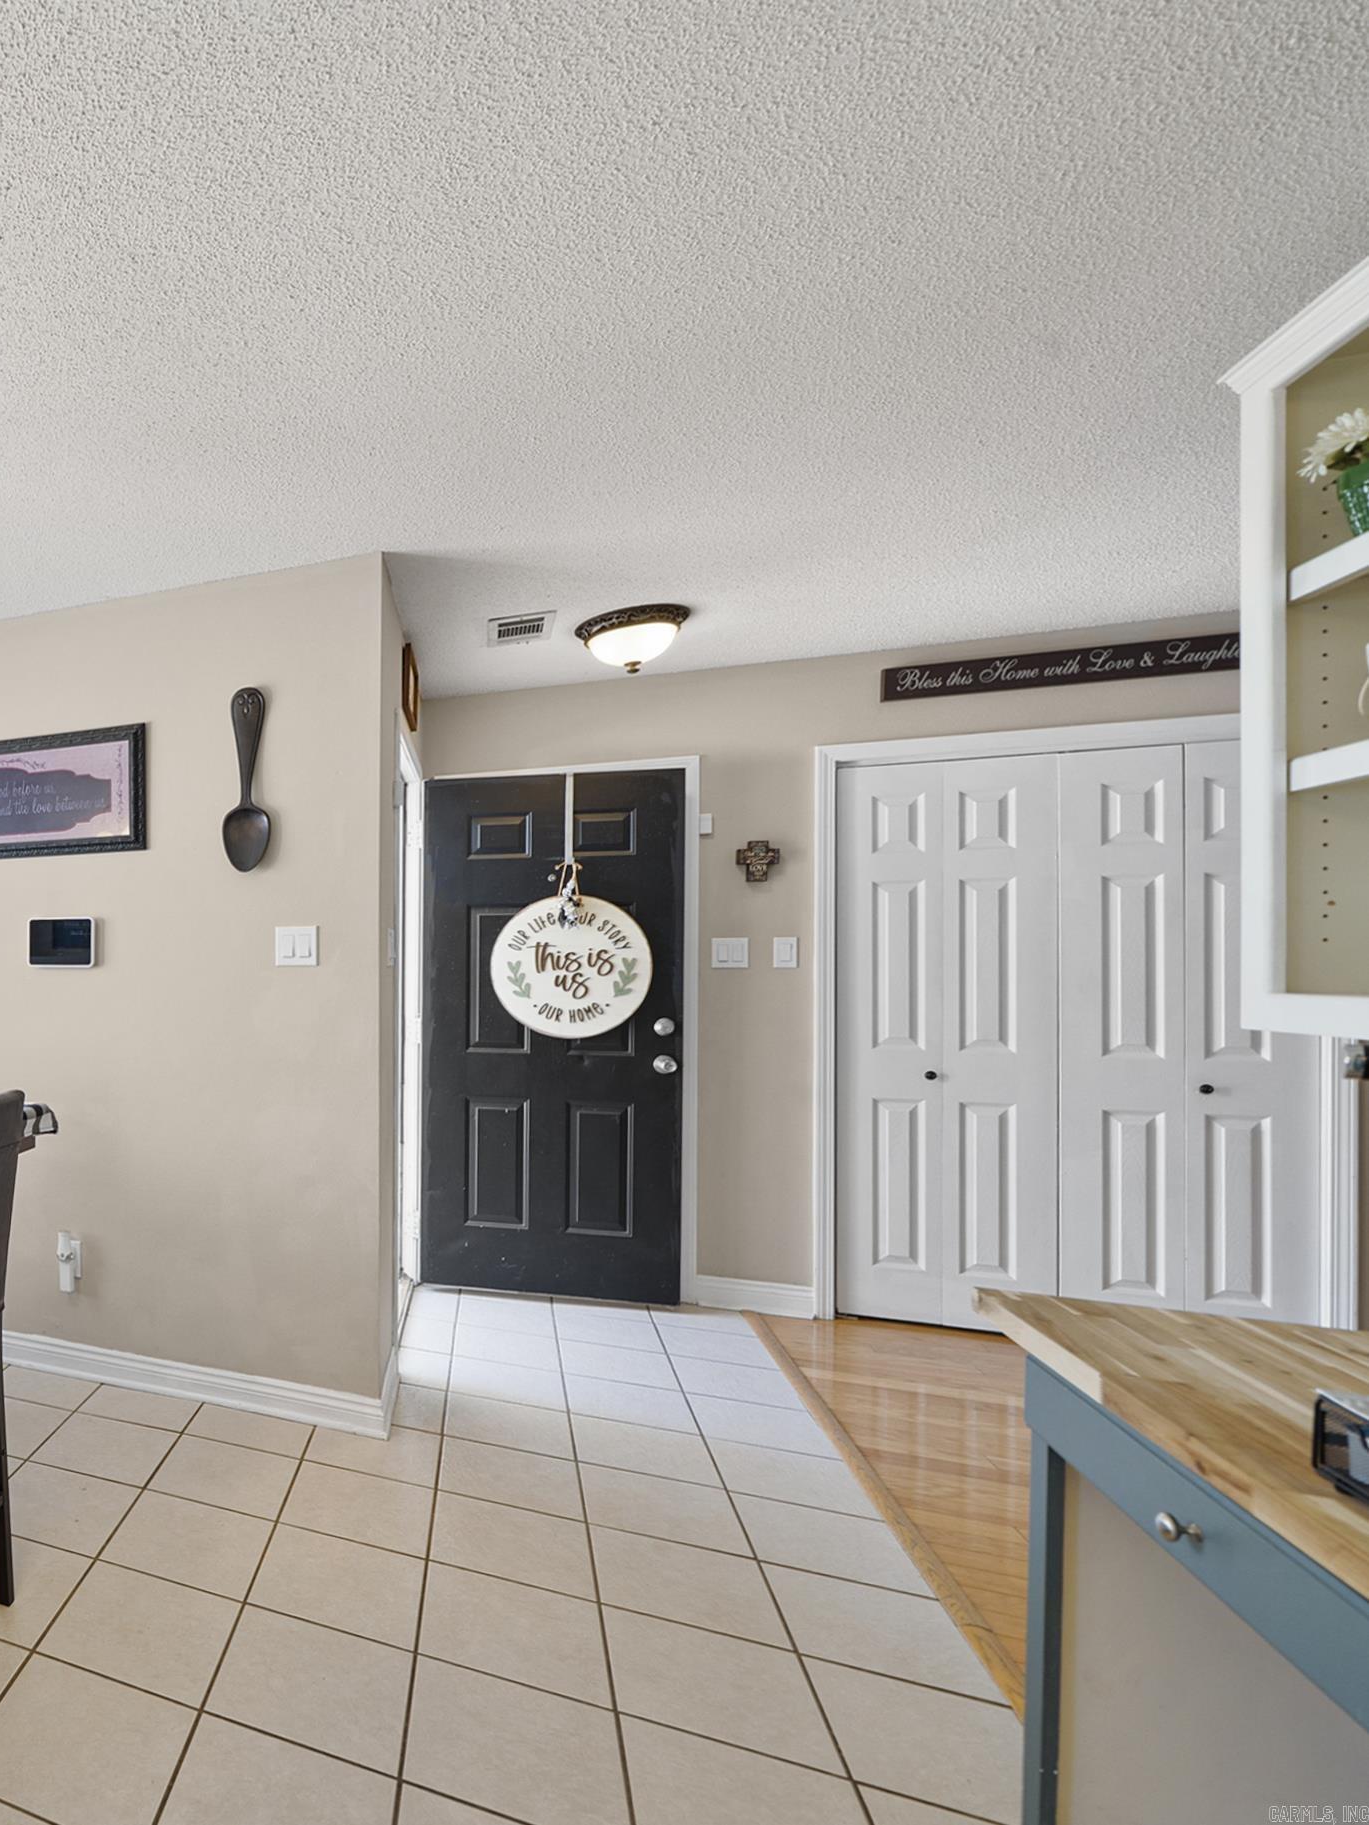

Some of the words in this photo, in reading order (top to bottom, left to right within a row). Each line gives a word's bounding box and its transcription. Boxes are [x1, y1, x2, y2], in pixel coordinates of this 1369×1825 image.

[896, 668, 943, 692] Bless
[946, 667, 974, 687] this
[979, 658, 1040, 684] Home
[1043, 656, 1081, 677] with
[1086, 649, 1135, 673] Love
[1139, 651, 1155, 668] &
[12, 779, 42, 801] before
[32, 797, 53, 814] love
[508, 929, 531, 951] OUR
[597, 919, 633, 950] STORY
[527, 942, 584, 974] this
[587, 948, 616, 977] is
[554, 972, 591, 1000] us
[538, 1003, 563, 1023] OUR
